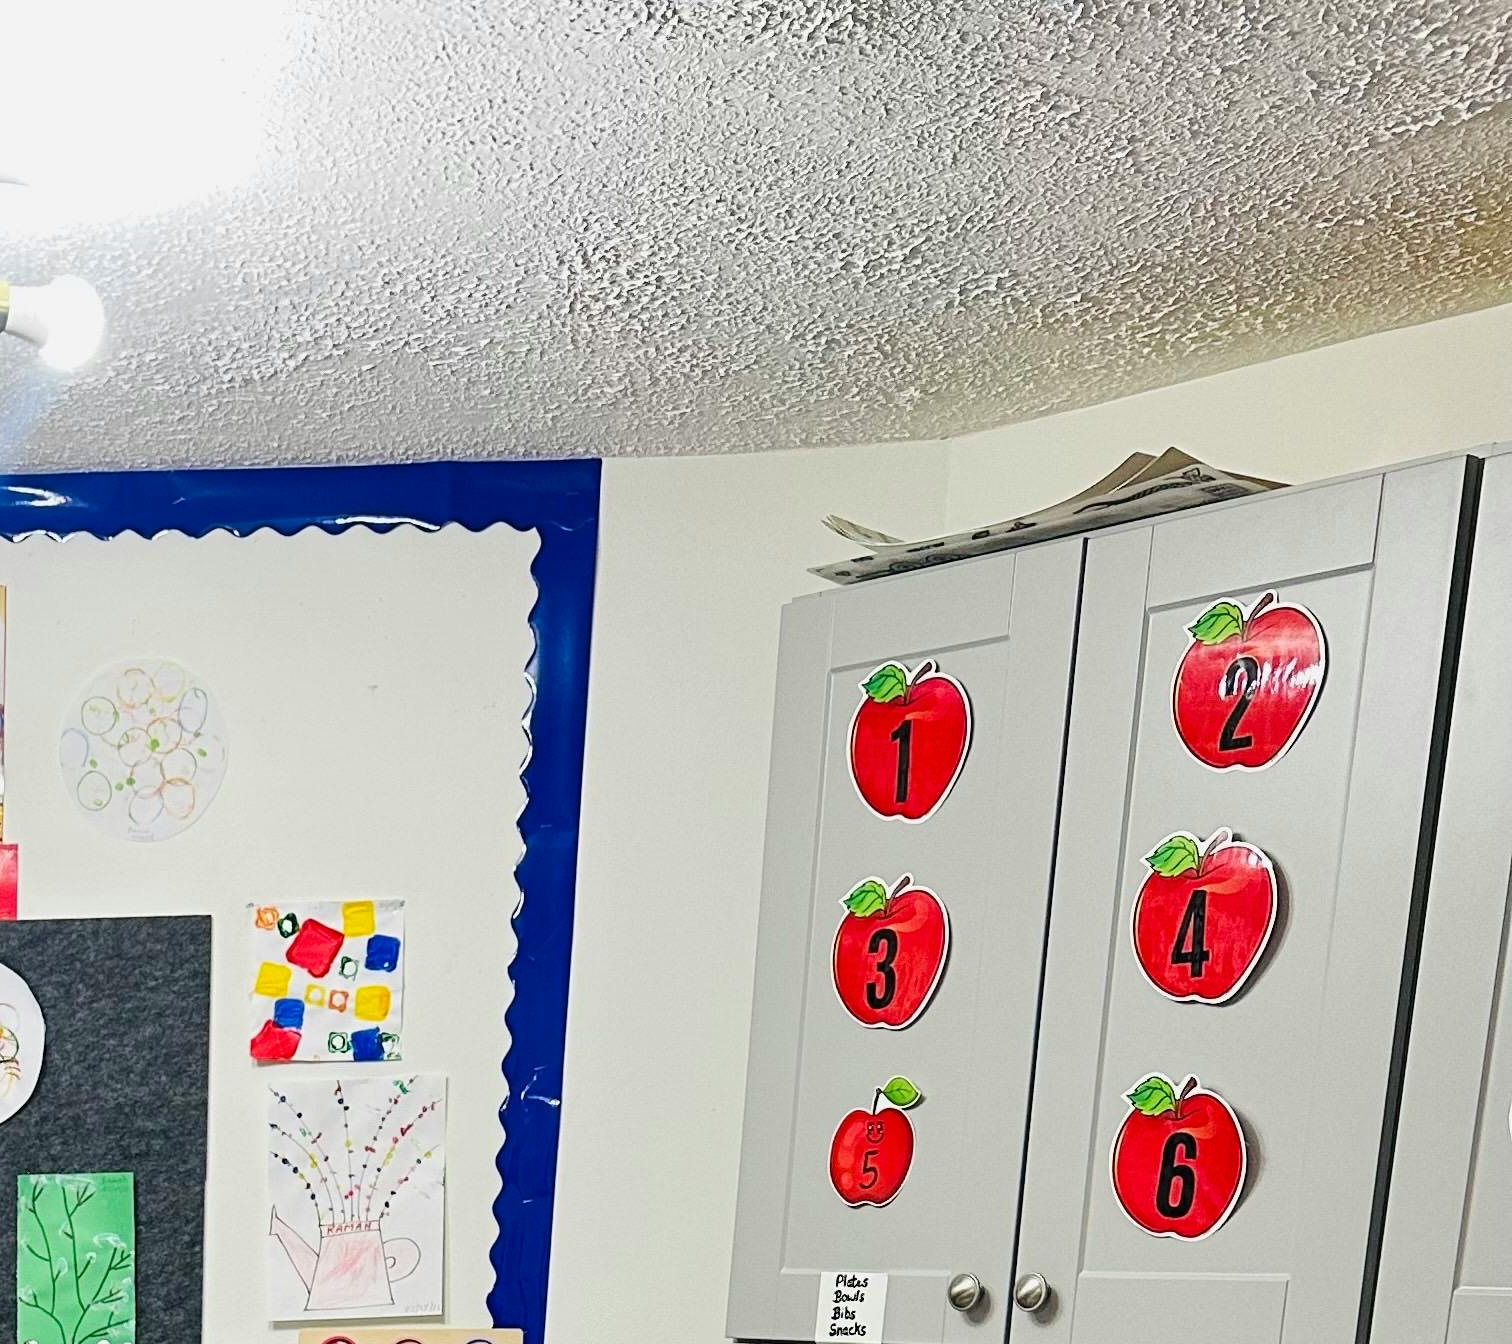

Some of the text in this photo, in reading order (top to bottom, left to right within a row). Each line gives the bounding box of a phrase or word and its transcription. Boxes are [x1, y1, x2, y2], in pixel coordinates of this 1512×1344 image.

[1219, 657, 1259, 752] 2
[890, 720, 915, 803] 1
[1170, 889, 1210, 978] 4
[867, 929, 899, 1009] 3
[859, 1150, 879, 1189] 5
[1156, 1132, 1197, 1219] 6
[833, 1290, 865, 1303] Bowls
[836, 1274, 869, 1288] Plates
[829, 1323, 867, 1336] Snacks
[831, 1306, 856, 1320] Bibs
